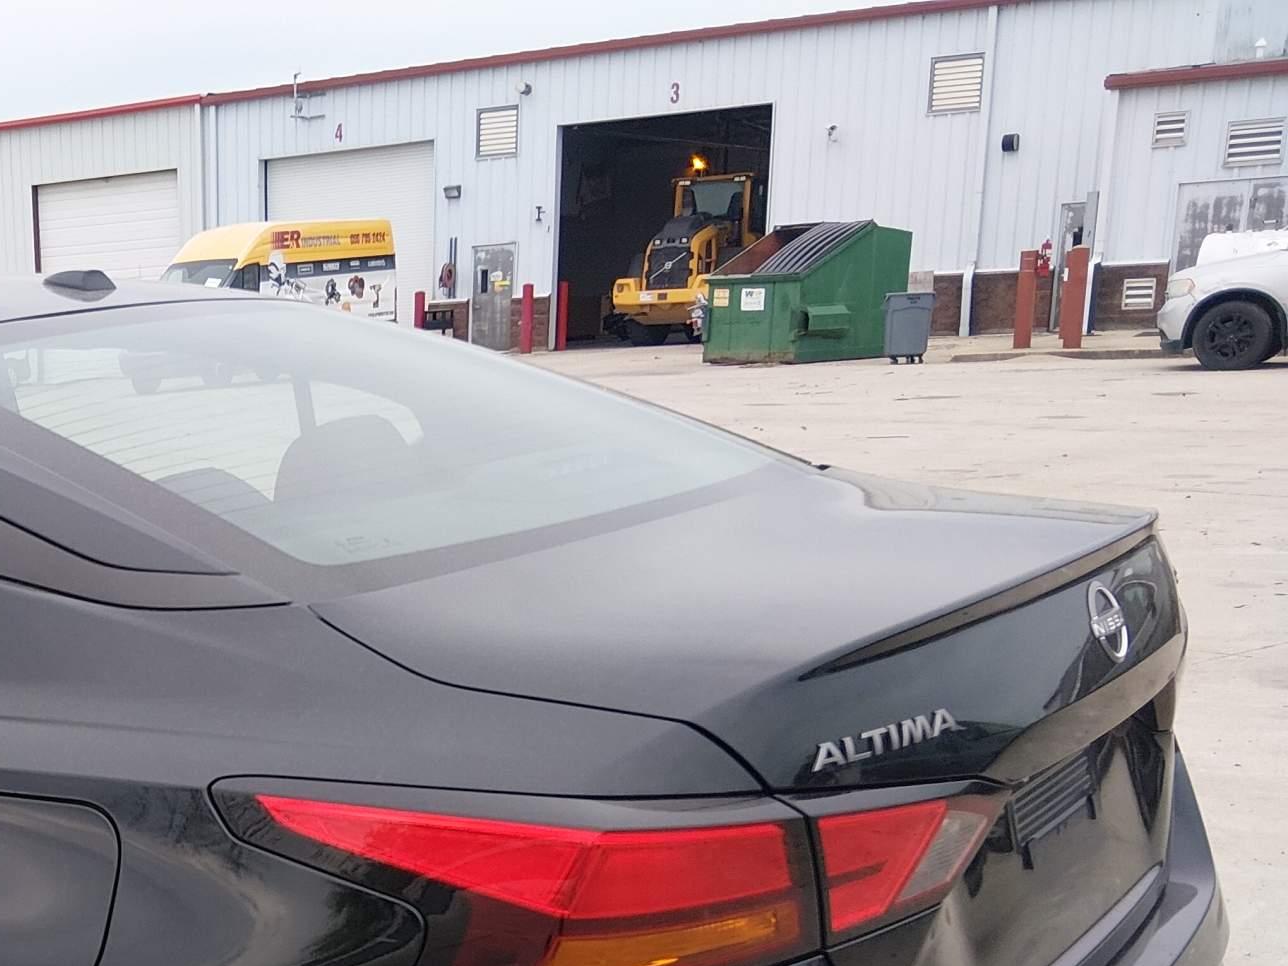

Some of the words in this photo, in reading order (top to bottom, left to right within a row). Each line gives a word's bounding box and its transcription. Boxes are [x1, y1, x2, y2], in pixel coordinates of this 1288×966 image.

[669, 82, 680, 104] 3
[334, 122, 343, 144] 4
[811, 708, 967, 773] ALTIMA
